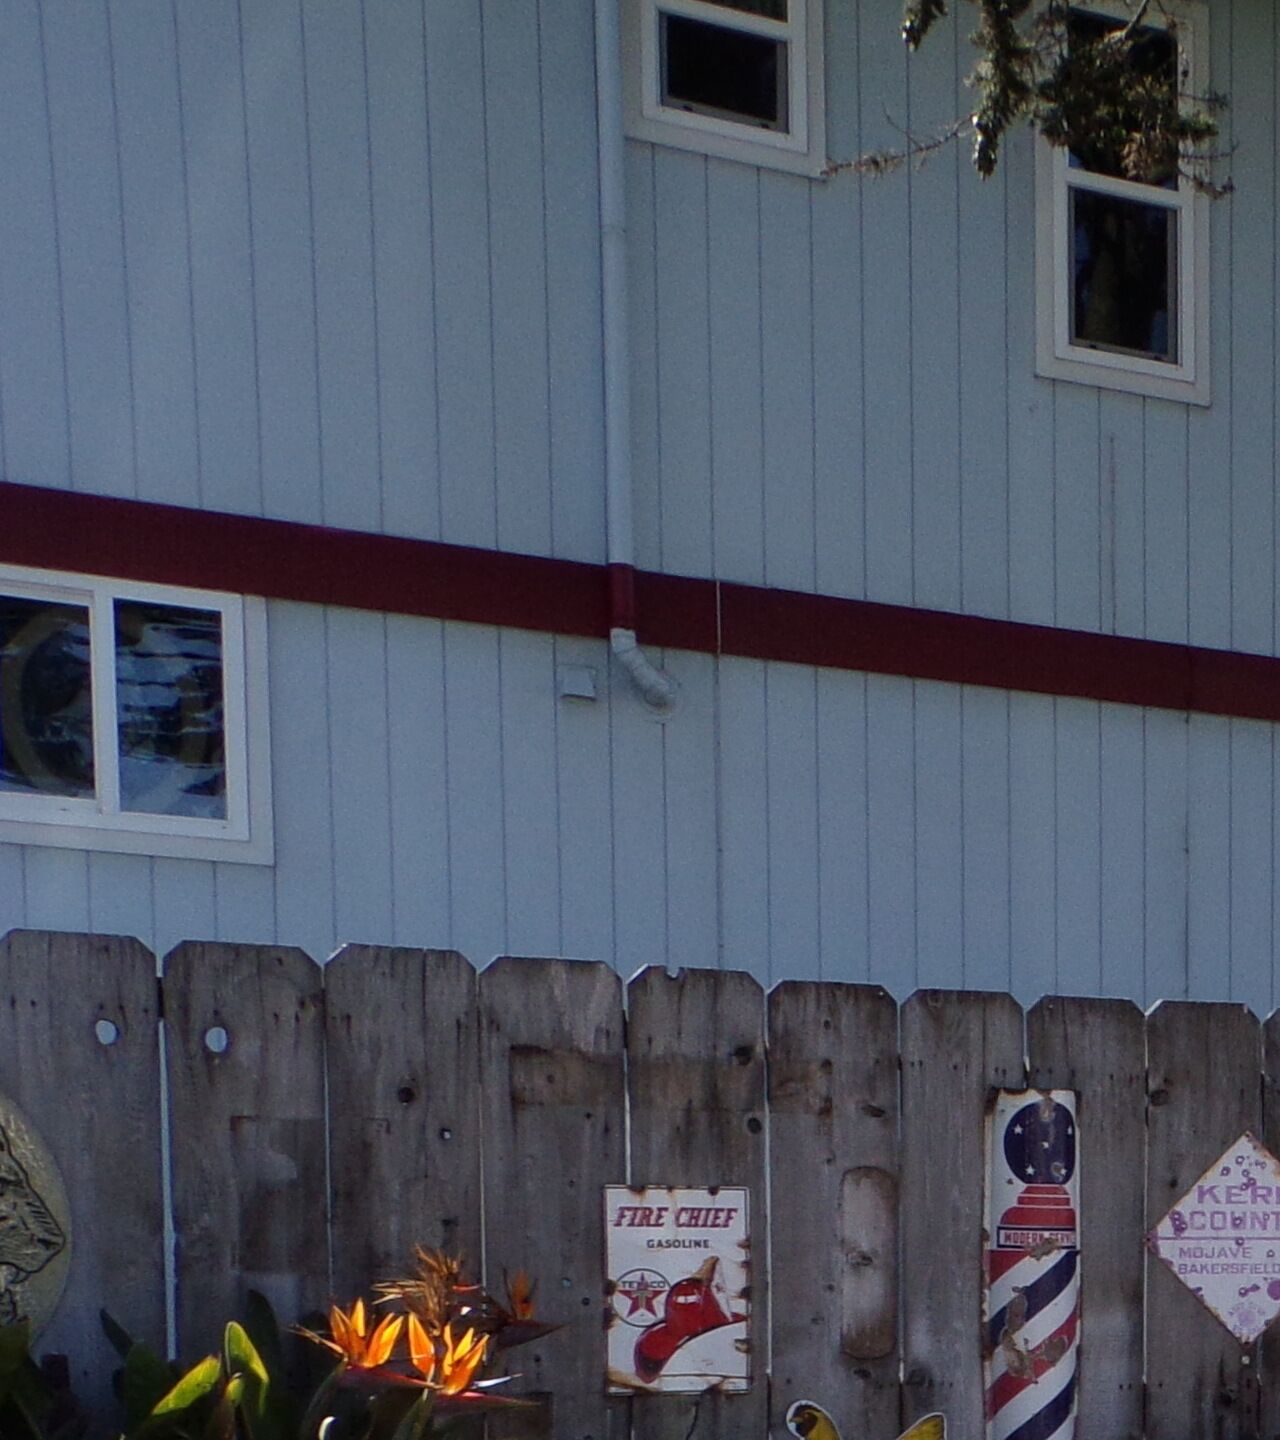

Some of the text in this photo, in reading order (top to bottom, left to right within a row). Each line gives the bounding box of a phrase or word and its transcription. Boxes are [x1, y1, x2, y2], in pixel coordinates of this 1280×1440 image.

[613, 1206, 738, 1228] FIRE CHIEF
[646, 1239, 710, 1249] GASOLINE
[1178, 1247, 1252, 1259] MOJAVE
